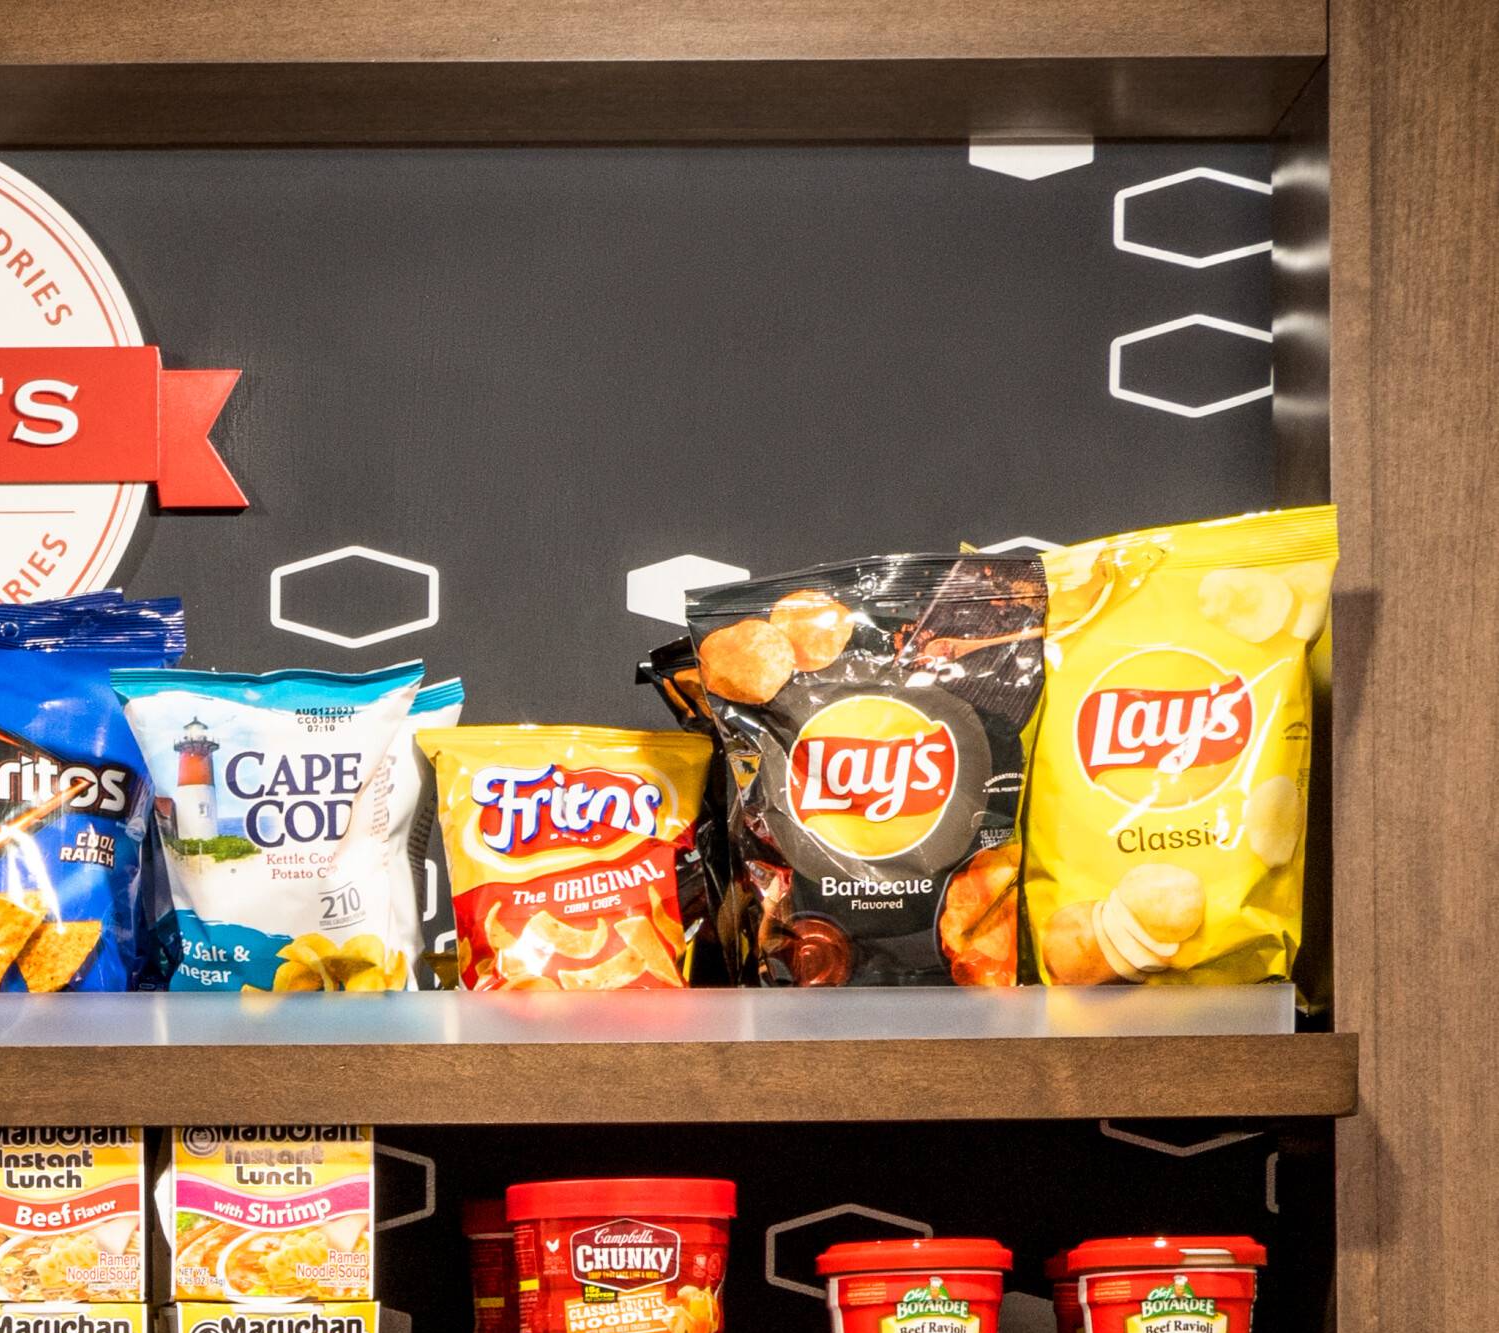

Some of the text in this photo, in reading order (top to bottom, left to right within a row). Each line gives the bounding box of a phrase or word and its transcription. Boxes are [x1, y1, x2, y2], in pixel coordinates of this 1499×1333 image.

[225, 751, 363, 800] CAPE
[799, 732, 947, 823] Lay's
[472, 764, 662, 853] Fritos
[246, 800, 354, 848] COD
[1116, 820, 1230, 855] Classic
[59, 846, 115, 867] RANCH
[266, 854, 305, 865] Kettle
[272, 868, 313, 879] Potato
[820, 875, 933, 898] Barbecue
[319, 887, 362, 919] 210
[564, 902, 589, 914] CORN
[850, 898, 904, 912] Flavored
[192, 941, 227, 962] Salt
[6, 1171, 83, 1190] Lunch
[15, 1198, 117, 1227] Beef Flavor
[214, 1196, 332, 1226] with Shrimp
[576, 1245, 674, 1273] CHUNKY
[568, 1302, 617, 1321] CLASSIC
[896, 1300, 969, 1320] BOYARDEE
[1141, 1299, 1215, 1317] BOYARDEE
